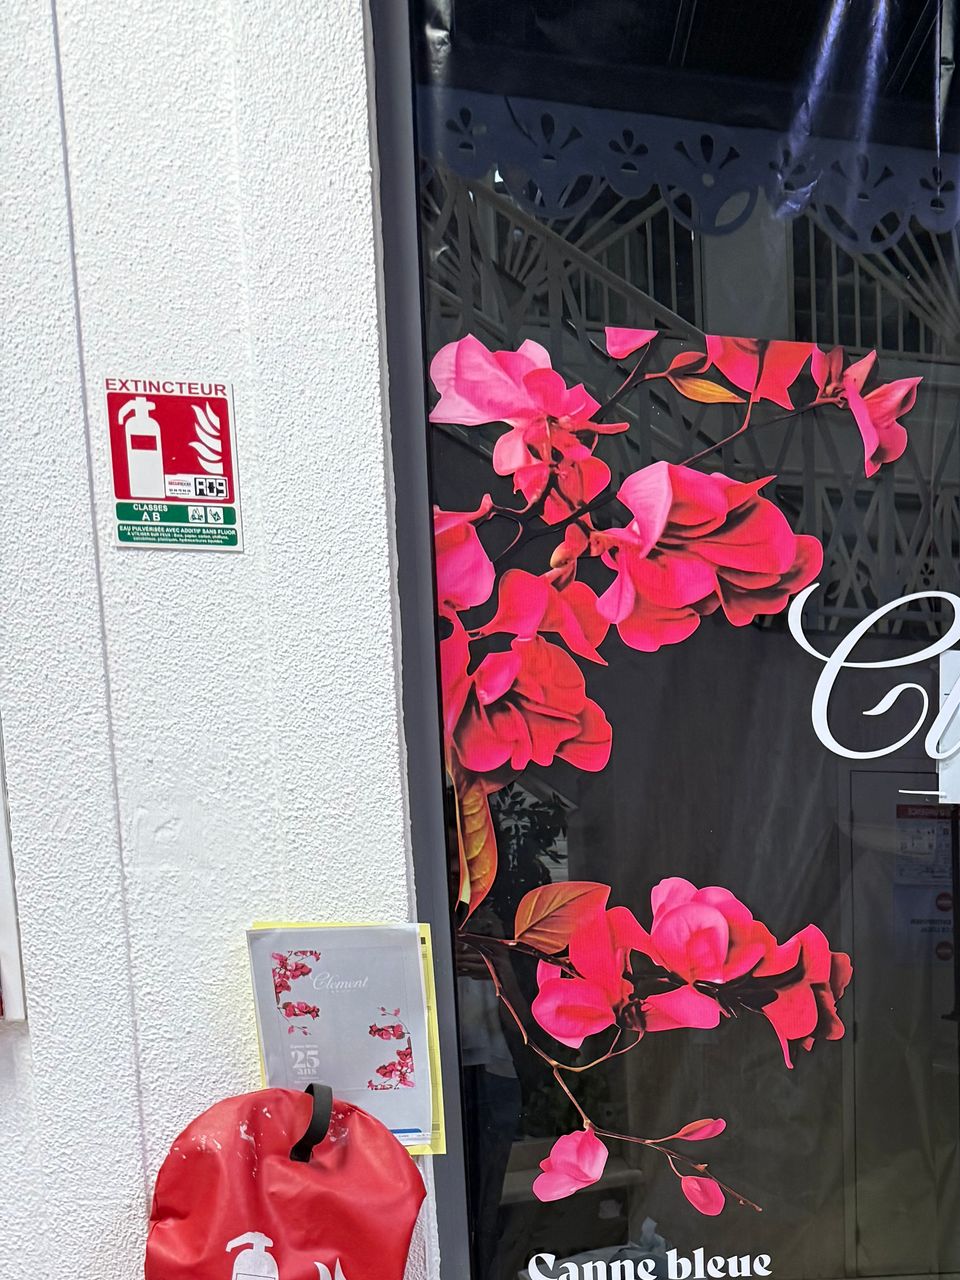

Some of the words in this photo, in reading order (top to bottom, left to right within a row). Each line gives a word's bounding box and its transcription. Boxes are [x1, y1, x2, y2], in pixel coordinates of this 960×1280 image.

[105, 378, 227, 396] EXTINCTEUR
[133, 503, 168, 512] CLASSES
[142, 511, 151, 521] A
[152, 512, 160, 521] B
[291, 1050, 320, 1068] 25
[665, 1247, 773, 1280] bleue
